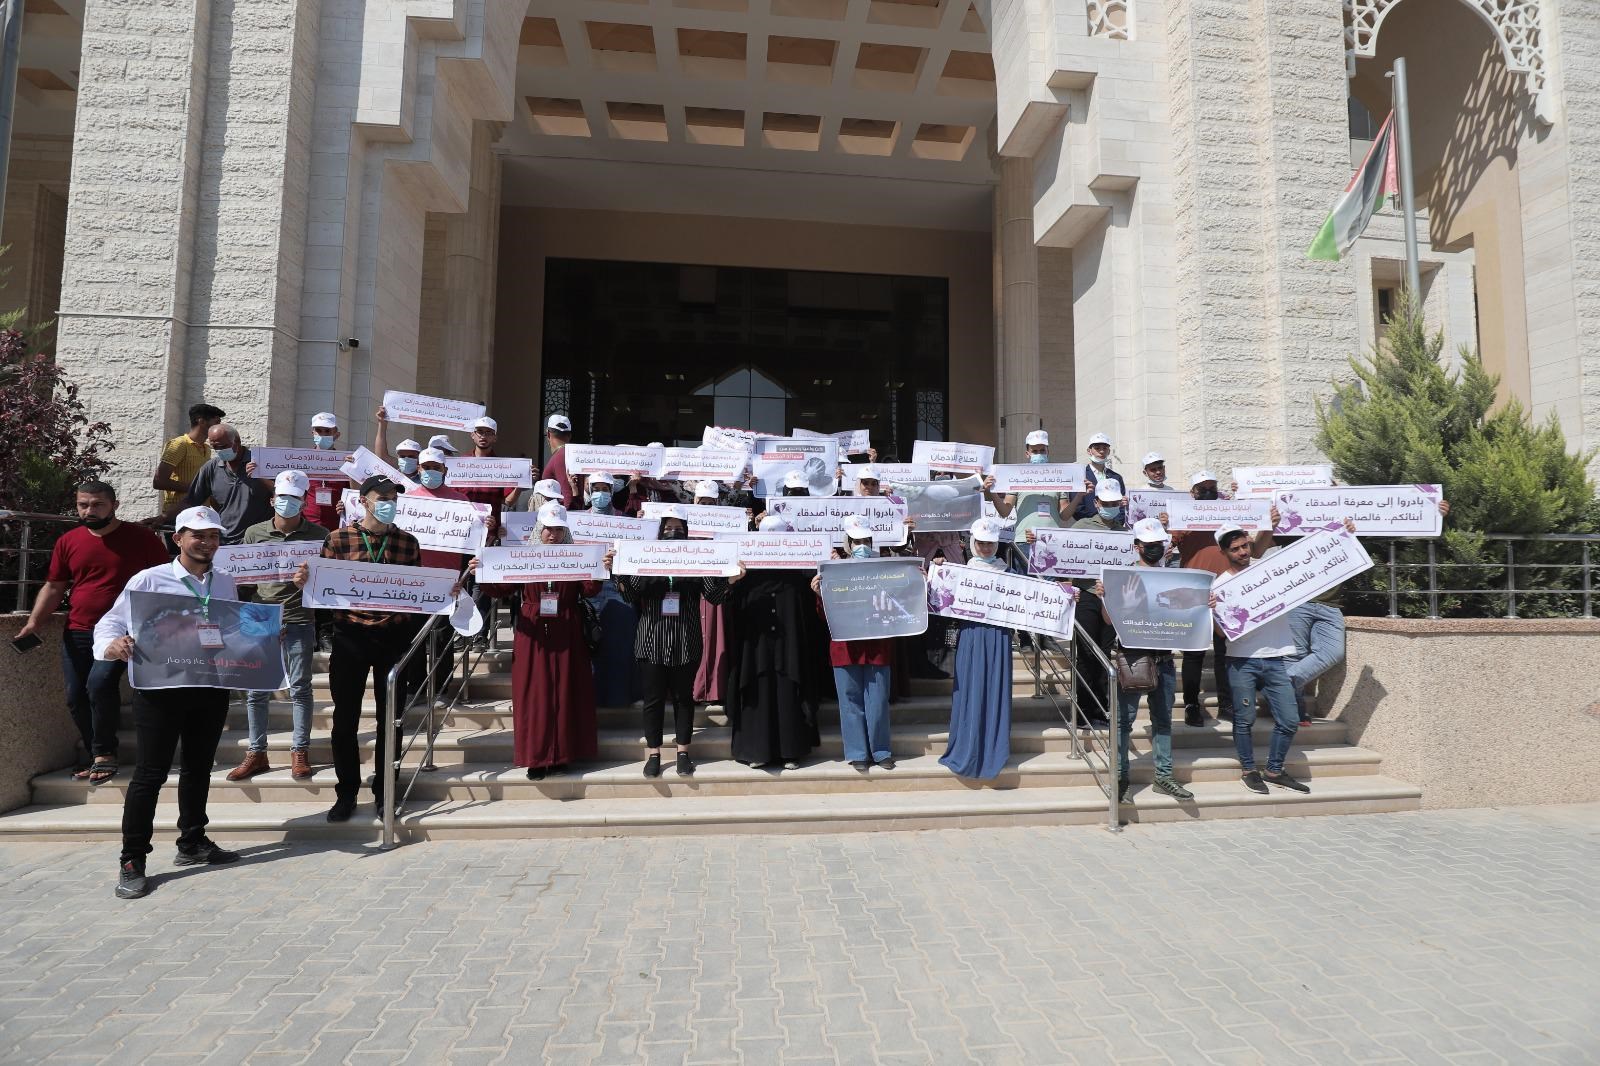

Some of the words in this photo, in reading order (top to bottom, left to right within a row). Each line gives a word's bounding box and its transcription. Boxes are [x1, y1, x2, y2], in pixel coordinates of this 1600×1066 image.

[1306, 496, 1340, 507] أصدقاء
[1344, 497, 1374, 508] معرفة
[1376, 496, 1393, 508] إلى
[1398, 496, 1424, 507] بادروا
[408, 508, 432, 518] معرفة
[436, 508, 450, 522] إلى
[798, 506, 828, 516] أصدقاء
[874, 508, 894, 518] بادروا
[452, 511, 474, 524] بادروا
[1232, 514, 1262, 522] المخدرات
[1306, 514, 1334, 522] ساحب
[798, 524, 822, 532] ساحب
[782, 538, 808, 548] التحية
[809, 540, 822, 548] كل
[1062, 539, 1092, 549] أصدقاء
[1095, 542, 1118, 552] معرفة
[1120, 543, 1134, 554] إلى
[1318, 536, 1341, 556] بادروا
[256, 549, 288, 560] والعلاج
[510, 550, 542, 559] وشبابنا
[544, 550, 583, 558] مستقبلنا
[643, 545, 682, 554] المخدرات
[682, 546, 714, 555] محاربة
[1060, 556, 1085, 565] ساحب
[1088, 557, 1122, 566] فالصاحب
[1302, 550, 1318, 565] إلى
[492, 562, 528, 571] المخدرات
[547, 562, 559, 570] بيد
[580, 562, 598, 570] ليس
[1273, 560, 1300, 578] معرفة
[350, 574, 388, 584] الشامخ
[390, 576, 426, 588] قضاؤنا
[960, 578, 993, 591] أصدقاء
[1240, 570, 1272, 597] أصدقاء
[1278, 571, 1315, 595] فالصاحب
[322, 586, 364, 600] بكم
[996, 584, 1021, 597] معرفة
[1024, 590, 1038, 602] إلى
[367, 590, 418, 604] ونفتخر
[420, 592, 446, 604] نعتز
[958, 597, 984, 606] ساحب
[1041, 592, 1064, 608] بادروا
[1250, 594, 1276, 611] ساحب
[987, 602, 1026, 614] فالصاحب
[208, 657, 262, 669] المخدرات
